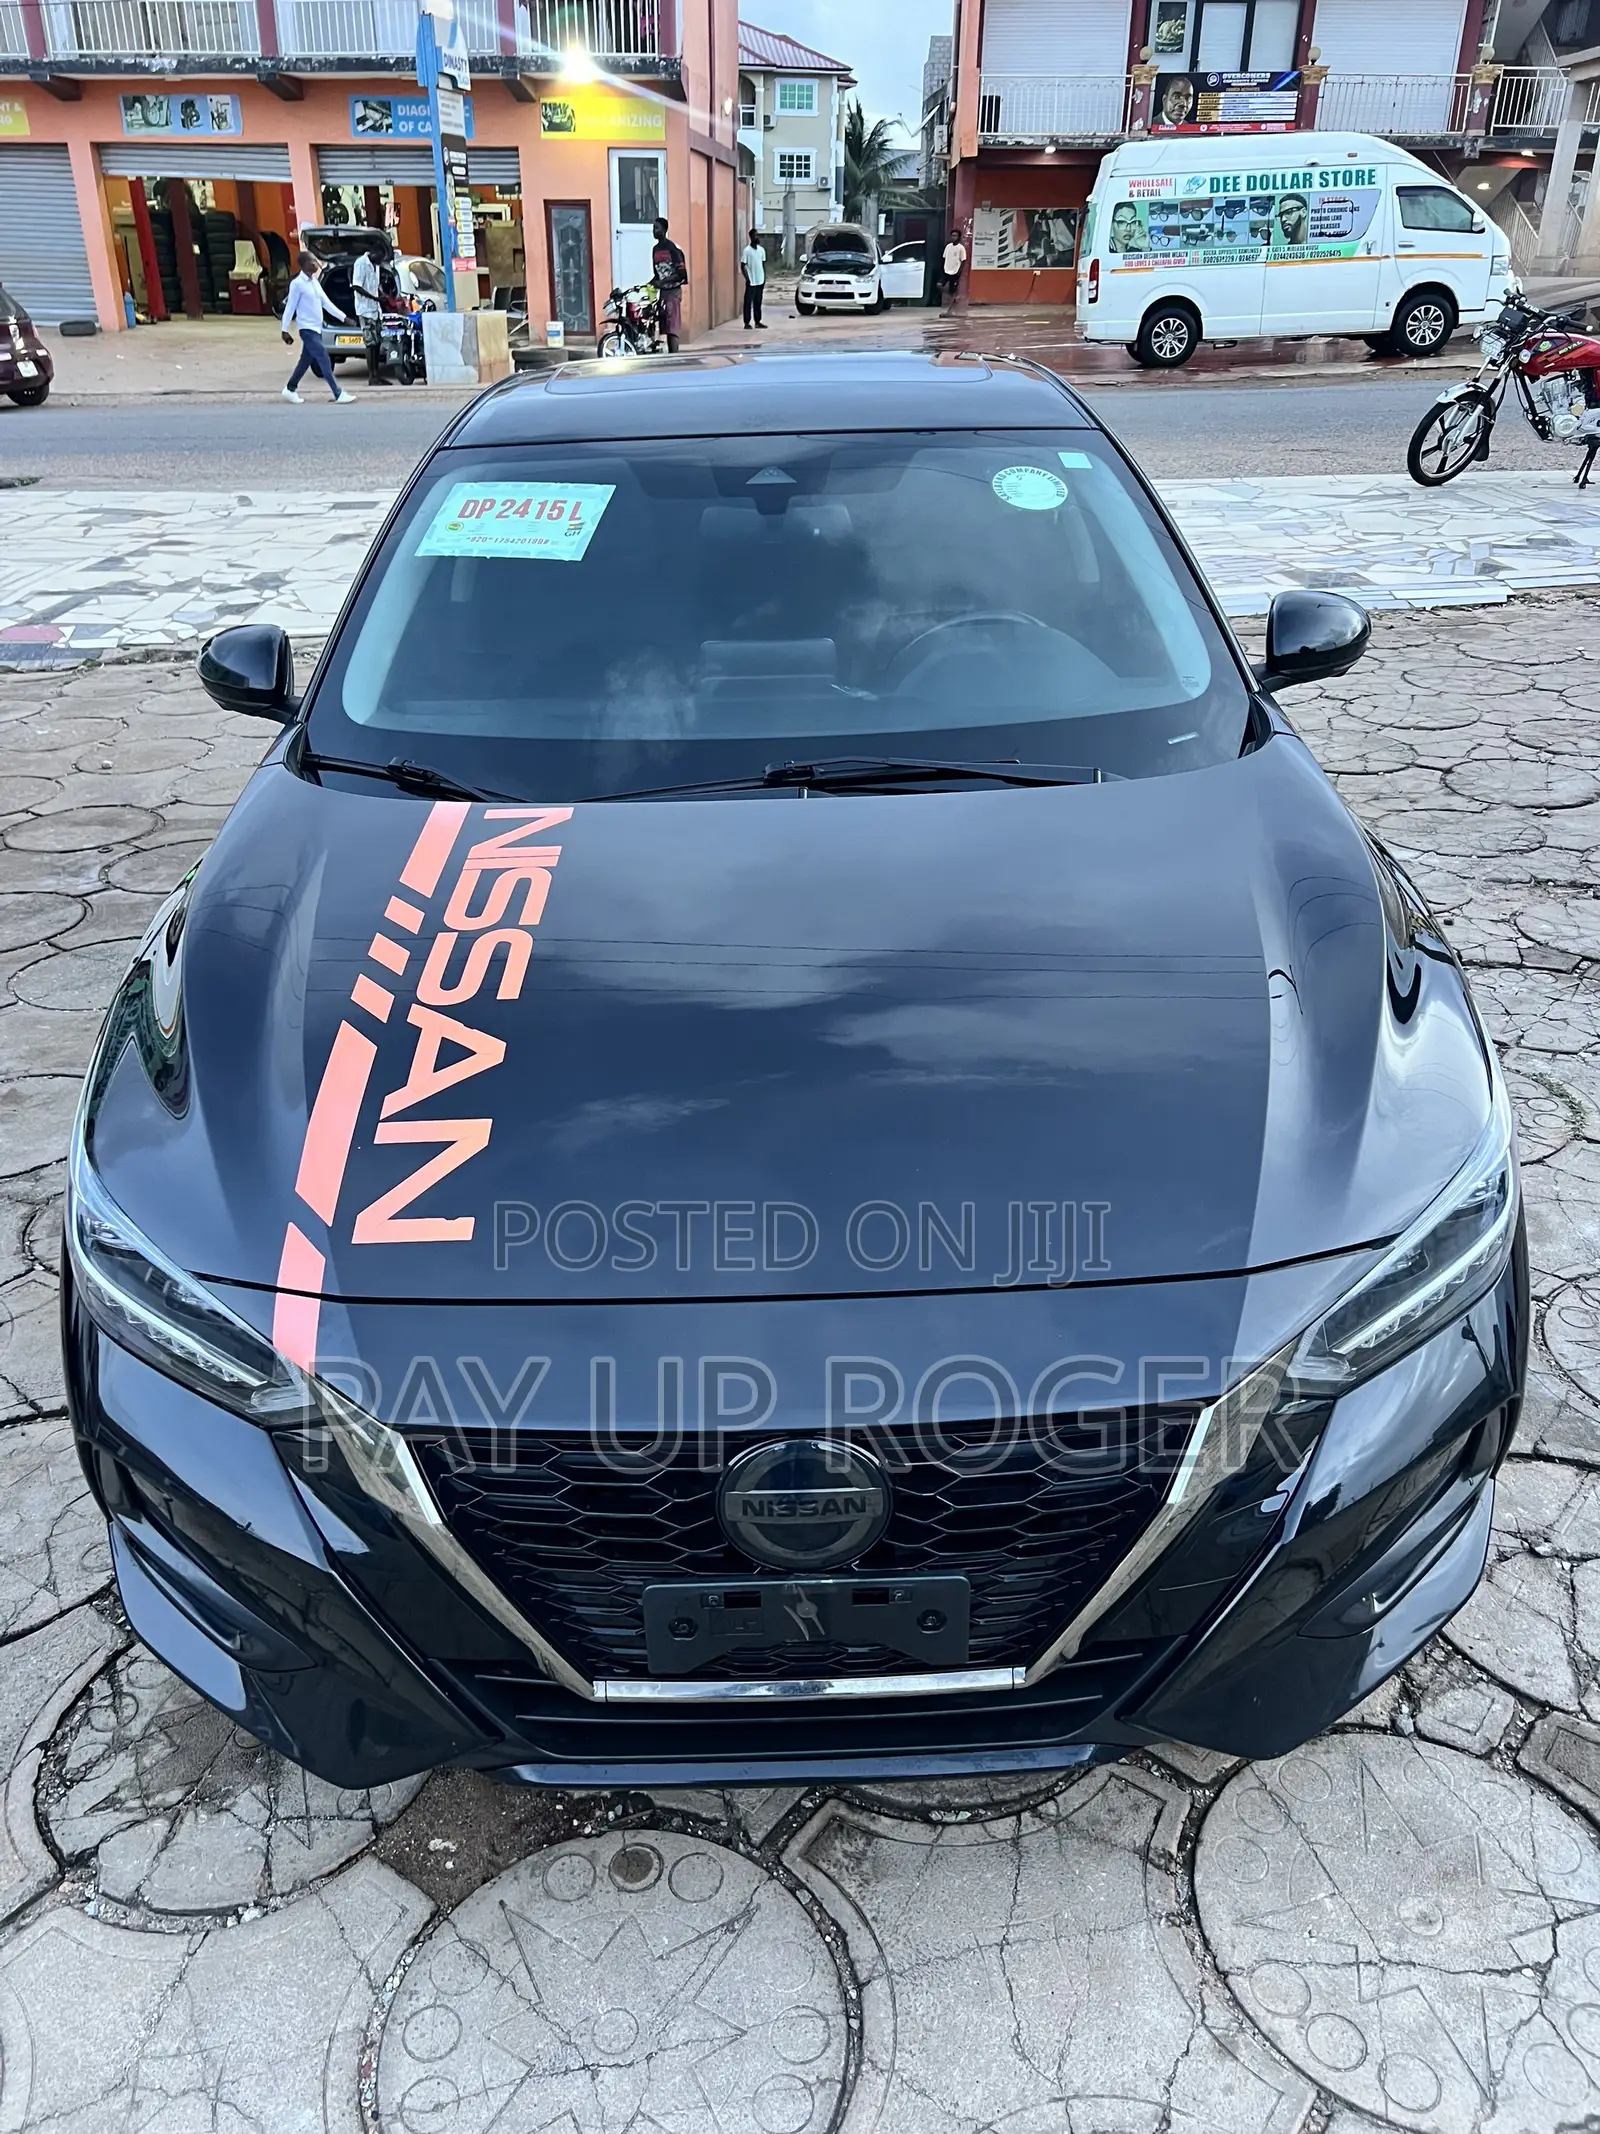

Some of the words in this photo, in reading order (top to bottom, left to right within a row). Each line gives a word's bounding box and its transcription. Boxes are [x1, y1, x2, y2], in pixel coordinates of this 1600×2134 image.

[399, 121, 415, 132] OF
[1128, 177, 1173, 188] WHOLESALE
[1209, 175, 1240, 194] DEE
[1246, 171, 1313, 191] DOLLAR
[1319, 168, 1376, 189] STORE
[1128, 190, 1135, 198] &
[1136, 188, 1161, 197] RETAIL
[1558, 340, 1583, 355] ROYAL
[1004, 467, 1049, 478] COMPANY
[457, 498, 496, 519] DP
[495, 498, 568, 522] 2415
[568, 501, 583, 522] L
[564, 530, 581, 538] GH
[351, 807, 574, 1244] NISSAN
[742, 1495, 867, 1518] NISSAN
